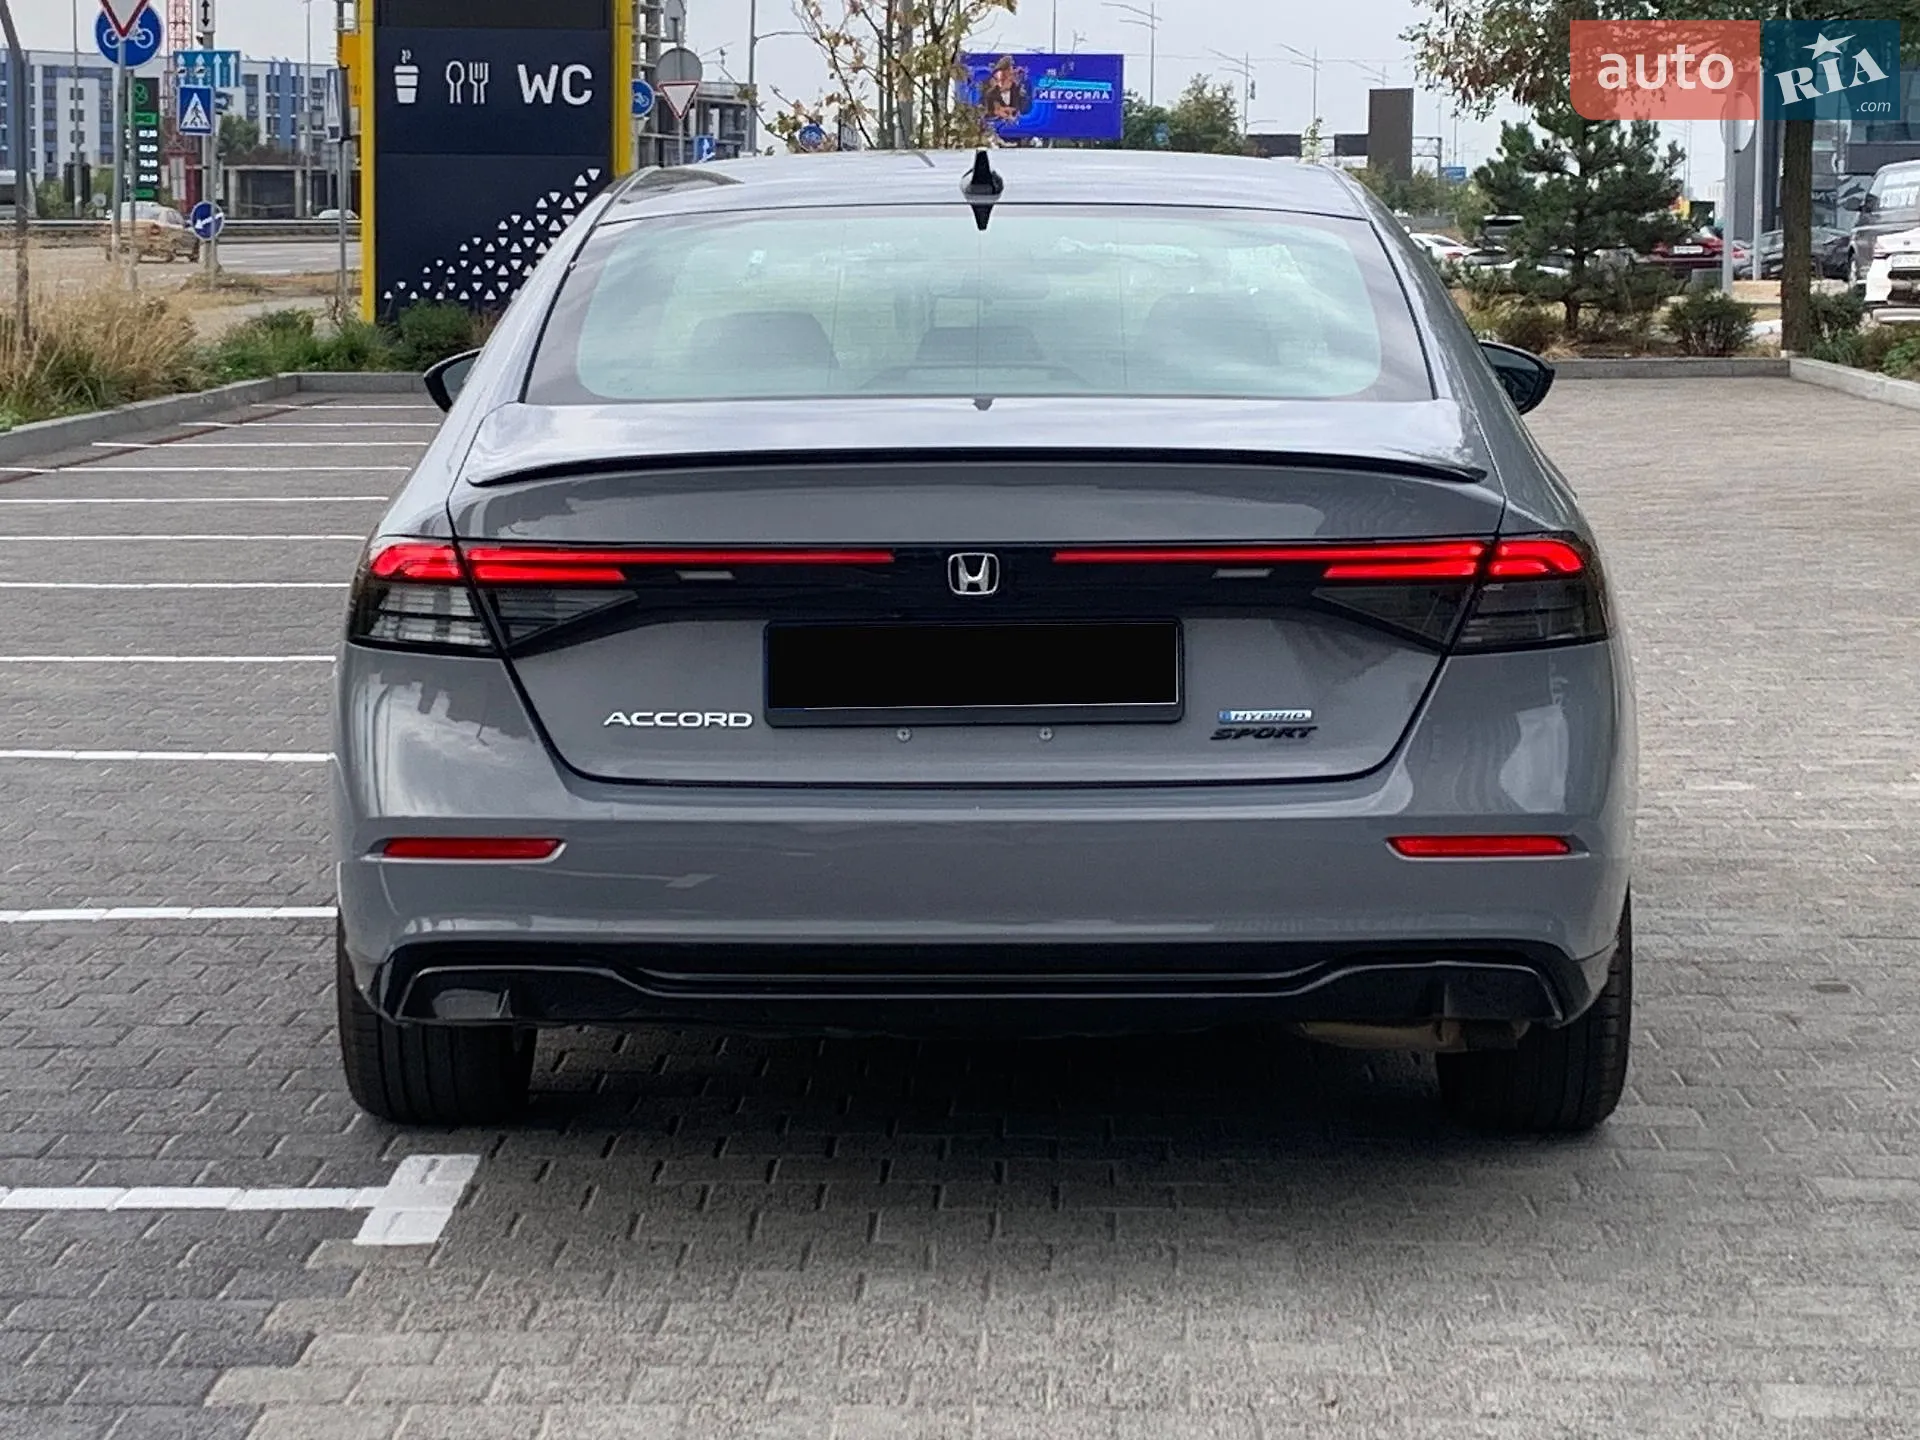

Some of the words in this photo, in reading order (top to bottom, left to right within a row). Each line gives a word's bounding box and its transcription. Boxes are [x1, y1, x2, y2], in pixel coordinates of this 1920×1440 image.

[517, 63, 592, 105] WC
[603, 711, 753, 727] ACCORD
[1233, 711, 1307, 721] HYBRID
[1210, 726, 1318, 740] SPORT
